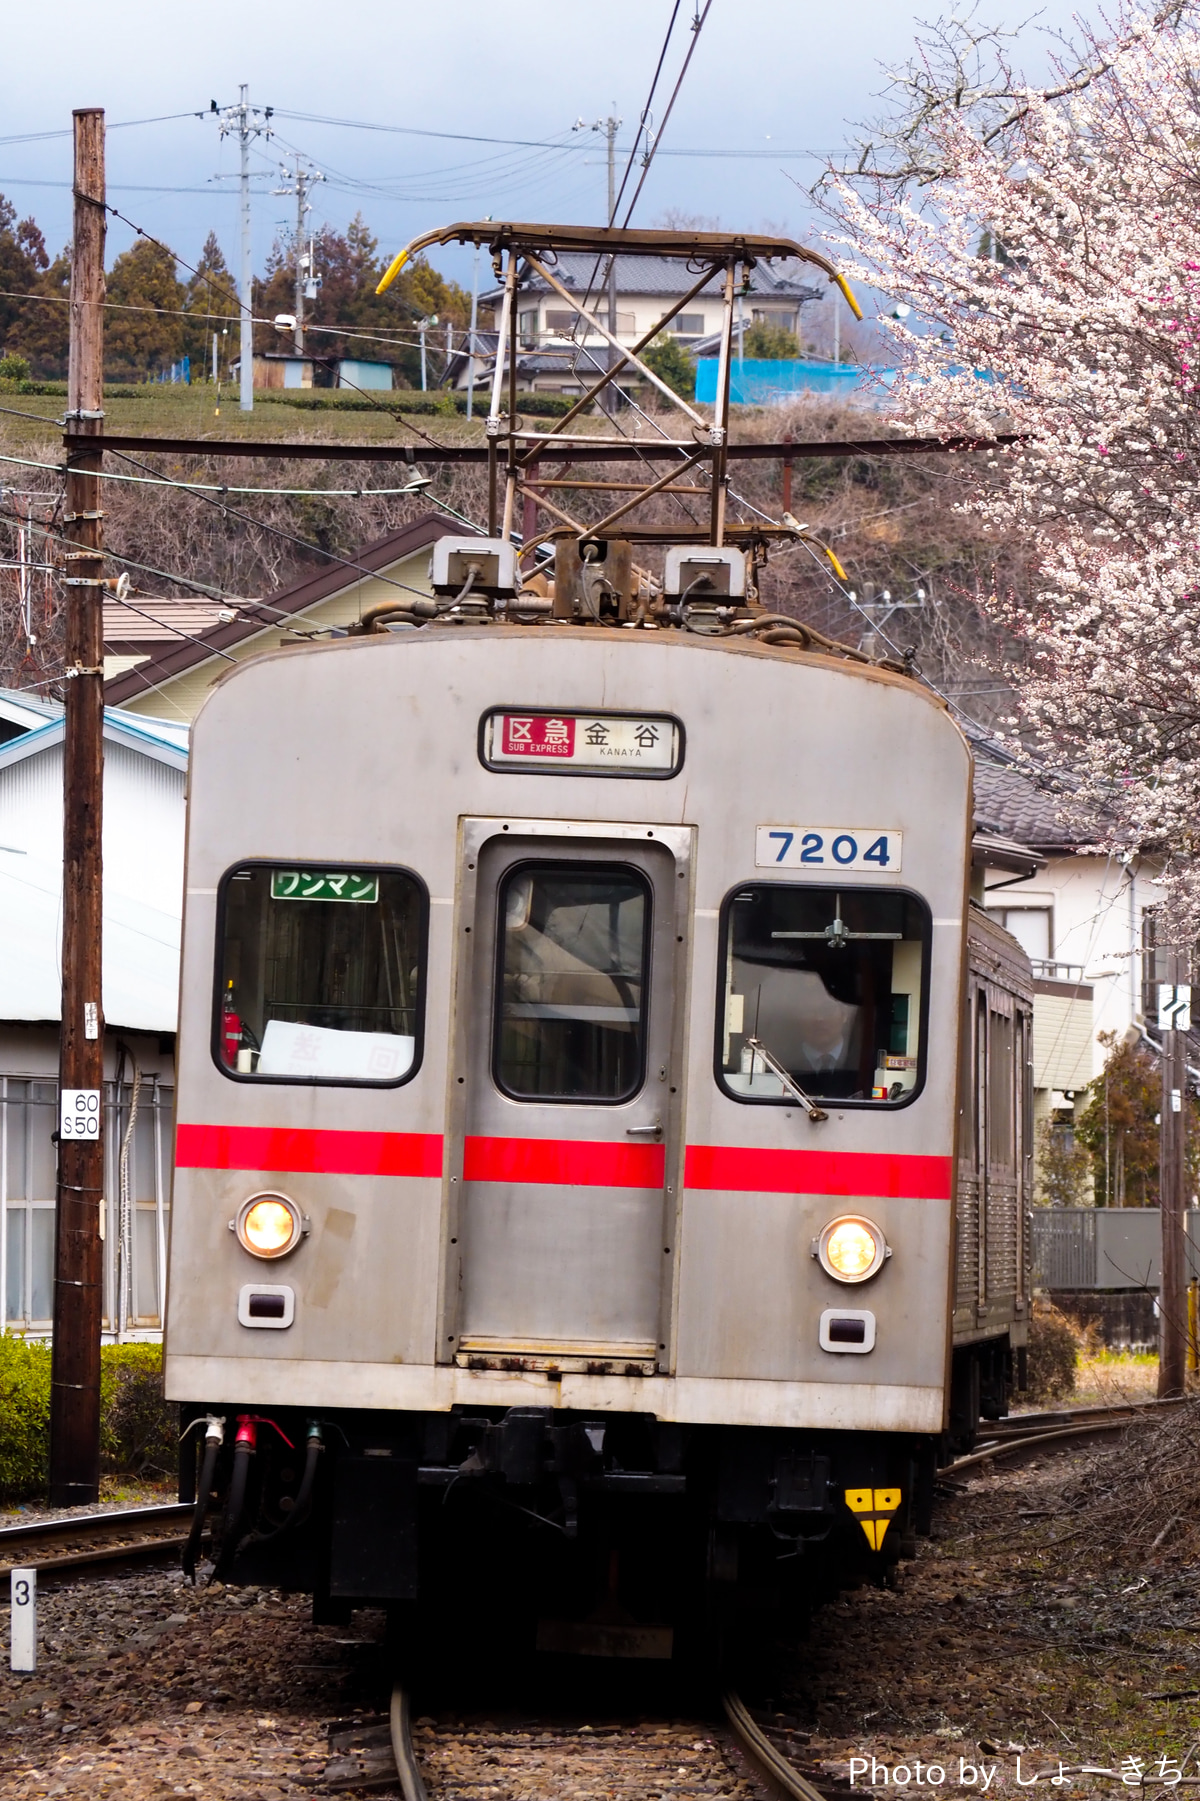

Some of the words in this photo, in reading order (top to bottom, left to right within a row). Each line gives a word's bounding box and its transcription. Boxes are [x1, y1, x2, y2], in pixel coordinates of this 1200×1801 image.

[508, 718, 570, 744] 区急
[585, 722, 660, 748] 金谷
[508, 743, 525, 752] SUB
[530, 744, 568, 755] EXPRESS
[600, 747, 642, 757] KANAYA
[769, 831, 890, 867] 7204
[277, 872, 374, 898] ワンマン
[75, 1094, 98, 1112] 60
[15, 1580, 30, 1606] 3
